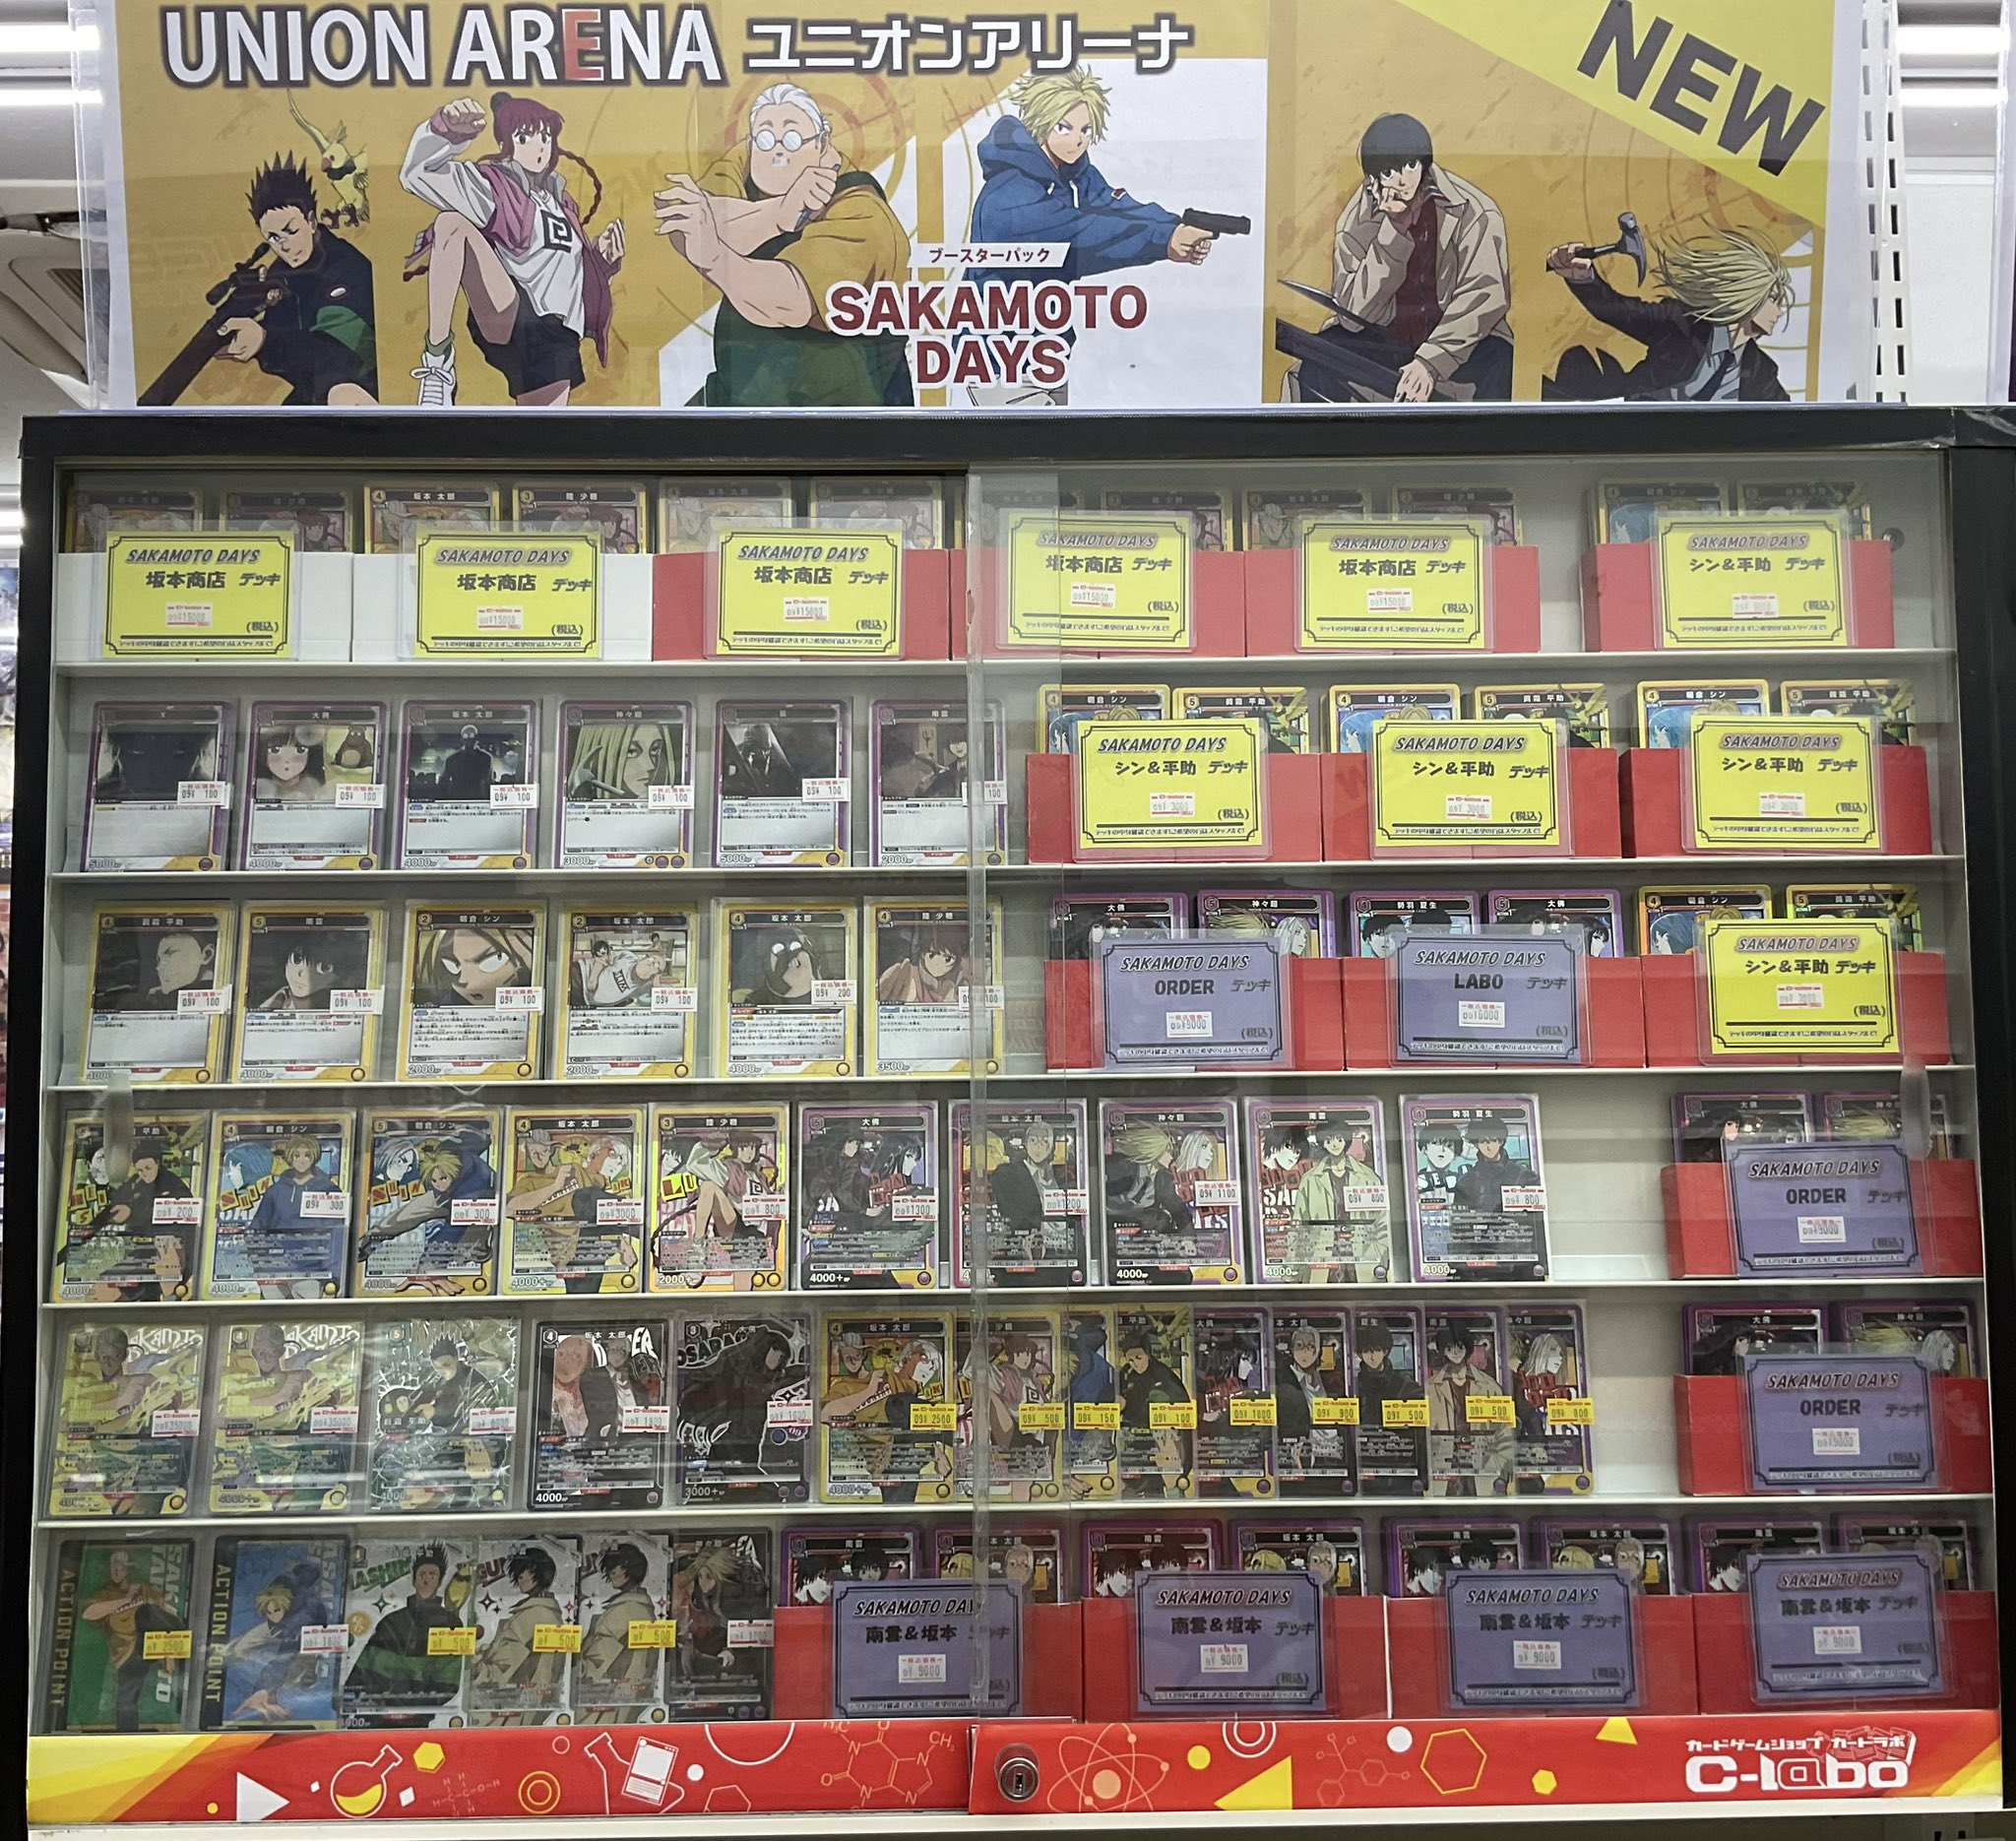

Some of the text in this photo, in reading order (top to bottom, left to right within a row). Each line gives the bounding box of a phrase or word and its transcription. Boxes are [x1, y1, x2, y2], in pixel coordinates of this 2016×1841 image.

[165, 7, 724, 85] UNION ARENA
[746, 17, 1190, 72] ユニオンアリーナ
[1577, 0, 1825, 177] NEW
[929, 246, 1050, 265] ブースターパック
[829, 285, 1148, 332] SAKAMOTO
[914, 339, 1067, 385] DAYS
[1038, 532, 1158, 549] SAKAMOTO DAYS
[1329, 537, 1450, 552] SAKAMOTO DAYS
[1689, 536, 1808, 549] SAKAMOTO DAYS
[126, 548, 261, 564] SAKAMOTO DAYS
[437, 548, 570, 564] SAKAMOTO DAYS
[737, 544, 869, 561] SAKAMOTO DAYS
[1045, 554, 1172, 573] 坂本商店 デッキ
[1339, 559, 1467, 577] 坂本商店 デッキ
[1689, 557, 1826, 572] シン&平助 デッキ
[146, 571, 282, 589] 坂本商店 デッキ
[457, 573, 592, 593] 坂本商店 デッキ
[754, 566, 889, 585] 坂本商店 デッキ
[1442, 603, 1475, 615] (税込)
[551, 624, 584, 636] (税込)
[1098, 736, 1228, 753] SAKAMOTO DAYS
[1394, 735, 1525, 751] SAKAMOTO DAYS
[1722, 734, 1841, 749] SAKAMOTO DAYS
[1114, 760, 1249, 776] シン&平助 デッキ
[1412, 761, 1549, 779] シン&平助 デッキ
[1721, 757, 1858, 773] シン&平助 デッキ
[182, 789, 220, 799] 09¥ 100
[340, 791, 377, 801] 09¥ 100
[494, 792, 532, 803] 09¥ 100
[653, 793, 689, 803] 09¥ 100
[806, 786, 843, 796] 09¥ 100
[987, 788, 1002, 798] 100
[1218, 808, 1250, 821] (税込)
[1510, 809, 1544, 822] (税込)
[1737, 936, 1858, 952] SAKAMOTO DAYS
[1119, 954, 1250, 972] SAKAMOTO DAYS
[1413, 950, 1546, 967] SAKAMOTO DAYS
[1744, 959, 1876, 976] シン&平助 デッキ
[612, 970, 631, 993] SLIM
[1155, 979, 1215, 996] ORDER
[499, 994, 536, 1005] 09¥ 100
[655, 994, 692, 1005] 09¥ 100
[814, 986, 851, 998] 09¥ 200
[984, 993, 999, 1004] 100
[181, 996, 220, 1007] 09¥ 100
[334, 997, 372, 1008] 09¥ 100
[1748, 1160, 1881, 1178] SAKAMOTO DAYS
[1199, 1188, 1236, 1199] 09¥ 1100
[1348, 1192, 1385, 1204] 09¥ 800
[1524, 1193, 1541, 1205] 800
[1785, 1187, 1847, 1205] ORDER
[176, 1206, 194, 1218] 200
[305, 1200, 345, 1212] 09¥ 300
[765, 1203, 781, 1215] 800
[473, 1208, 490, 1220] 300
[1767, 1372, 1900, 1390] SAKAMOTO DAYS
[1233, 1409, 1272, 1420] 09¥ 1000
[1316, 1407, 1354, 1419] 09¥ 900
[1386, 1410, 1424, 1421] 09¥ 500
[1469, 1405, 1507, 1417] 09¥ 500
[1550, 1409, 1565, 1419] 09¥
[1799, 1399, 1861, 1417] ORDER
[914, 1414, 952, 1425] 09¥ 2500
[1022, 1414, 1060, 1425] 09¥ 500
[1078, 1414, 1115, 1425] 09¥ 150
[1153, 1414, 1191, 1425] 09¥ 100
[1778, 1570, 1900, 1588] SAKAMOTO DAYS
[1157, 1589, 1292, 1607] SAKAMOTO DAYS
[1466, 1588, 1600, 1605] SAKAMOTO DAYS
[853, 1599, 941, 1618] SAKAMOTO
[1170, 1617, 1263, 1635] 南雲&坂本
[1479, 1613, 1571, 1631] 南雲&坂本
[50, 1568, 76, 1708] ACTION POINT
[205, 1563, 232, 1703] ACTION POINT
[557, 1635, 576, 1646] 500
[654, 1629, 671, 1641] 500
[865, 1624, 958, 1643] 南雲&坂本
[453, 1637, 471, 1648] 500
[1221, 1654, 1243, 1666] 9000
[1533, 1651, 1556, 1664] 9000
[917, 1665, 941, 1678] 9000
[1685, 1735, 1906, 1752] カードゲームショップ カードラボ
[1685, 1752, 1910, 1794] C-labo
